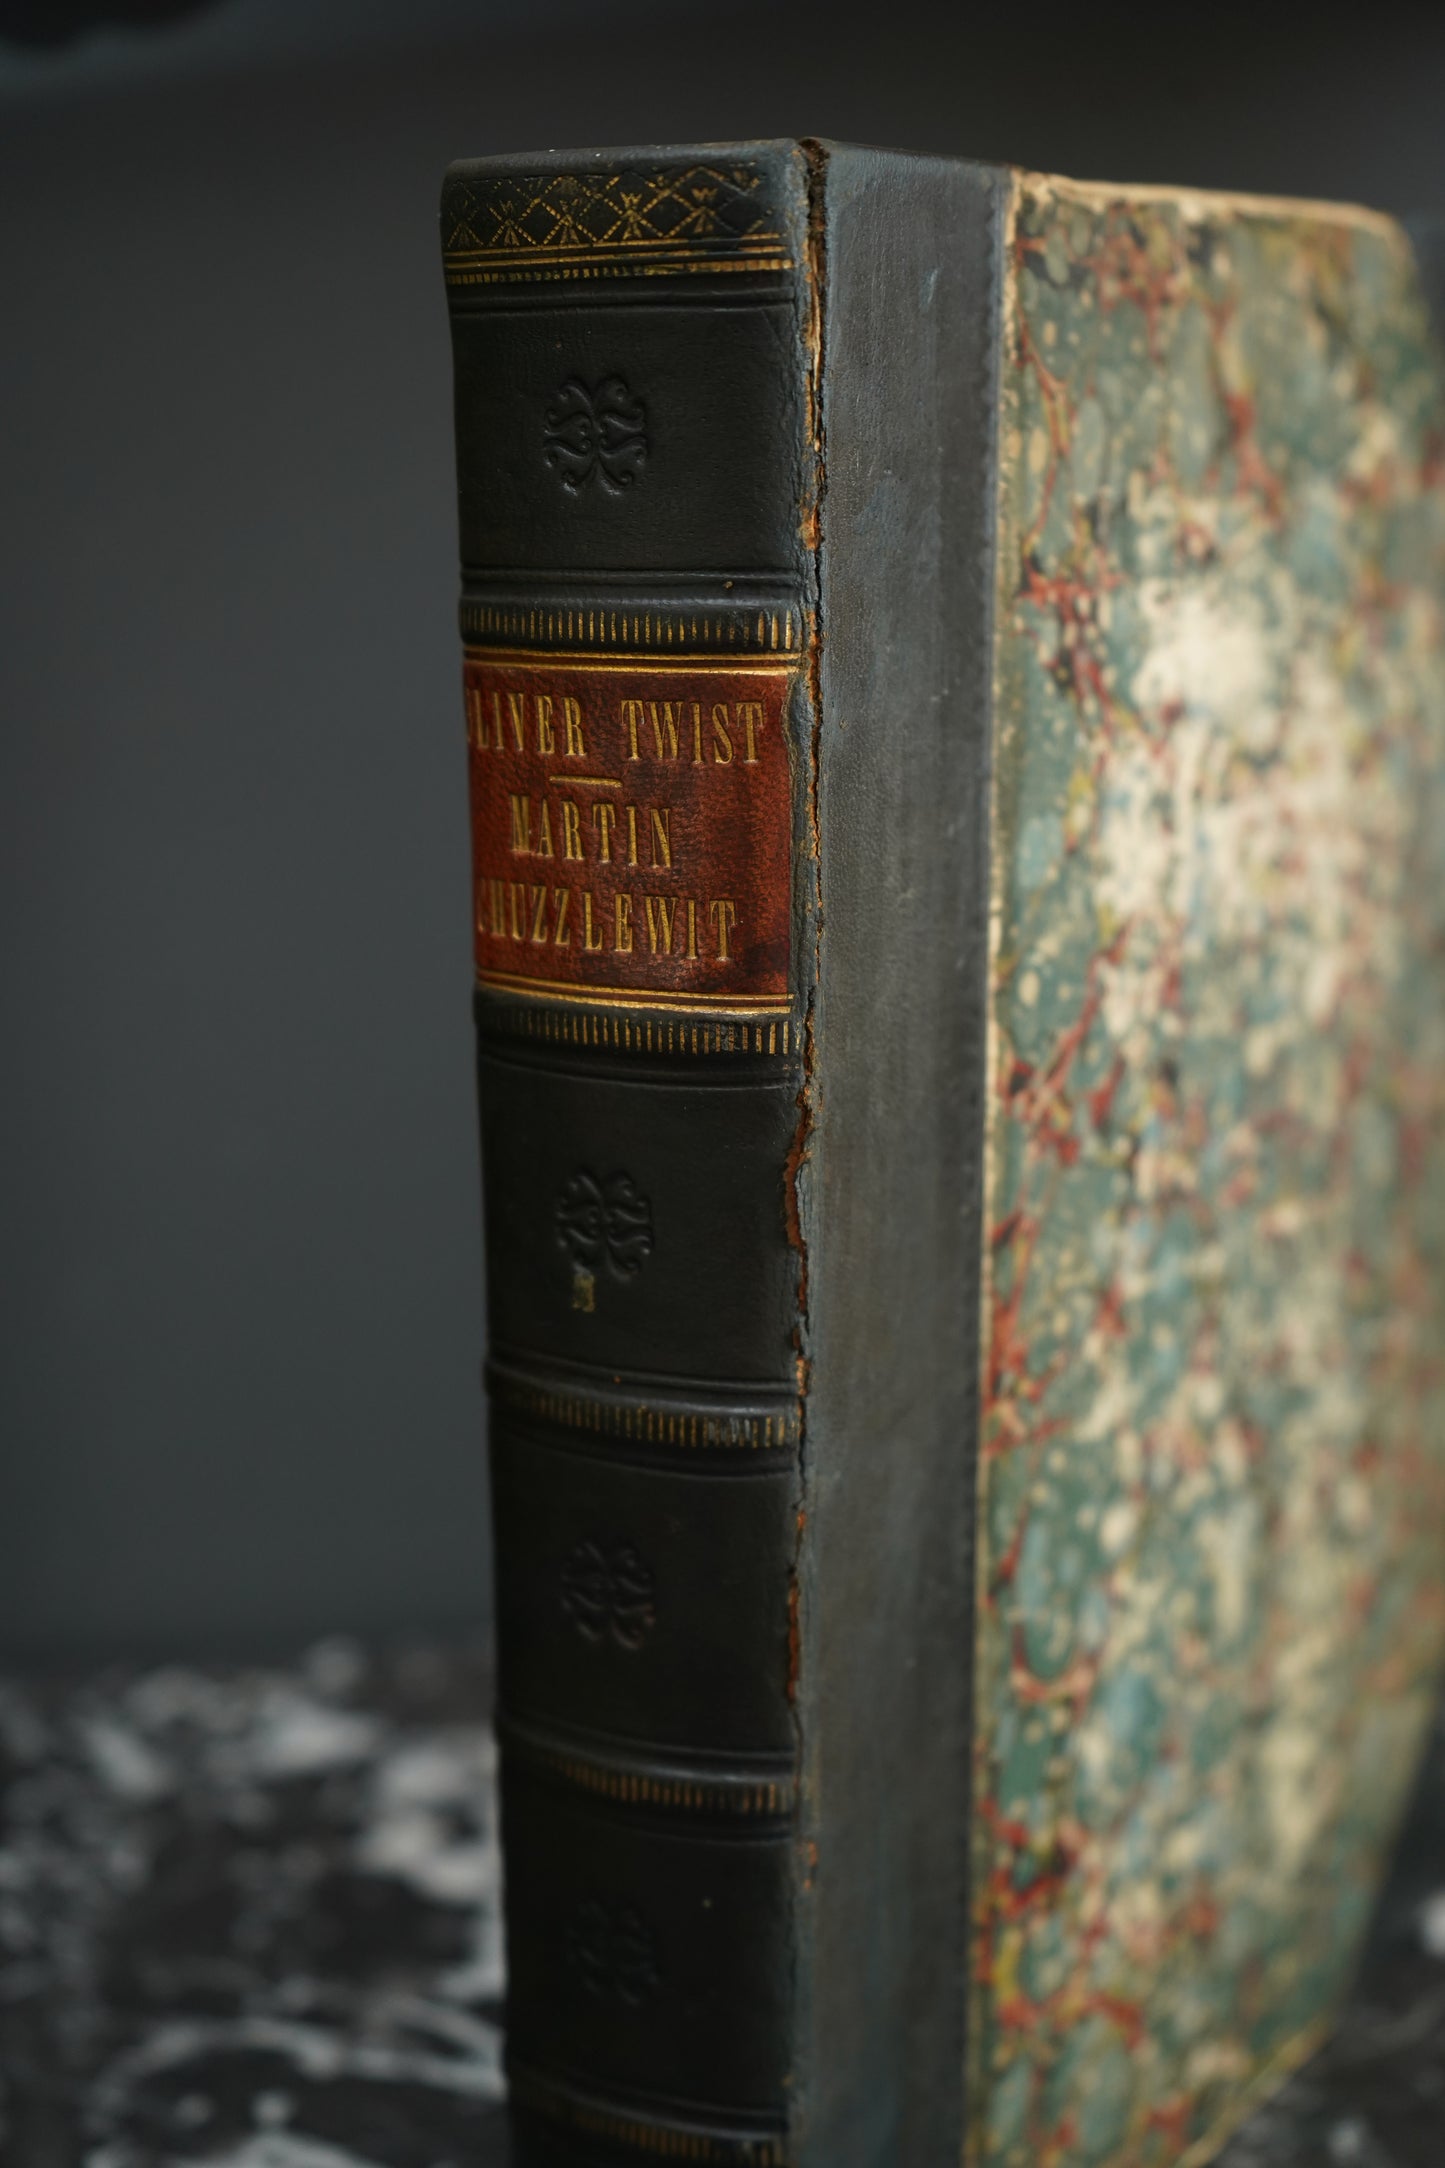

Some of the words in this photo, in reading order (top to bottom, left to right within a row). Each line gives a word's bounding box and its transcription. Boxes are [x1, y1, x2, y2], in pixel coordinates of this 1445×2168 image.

[466, 688, 588, 756] LIVER
[620, 699, 765, 764] TWIST
[510, 794, 672, 868] MARTIN
